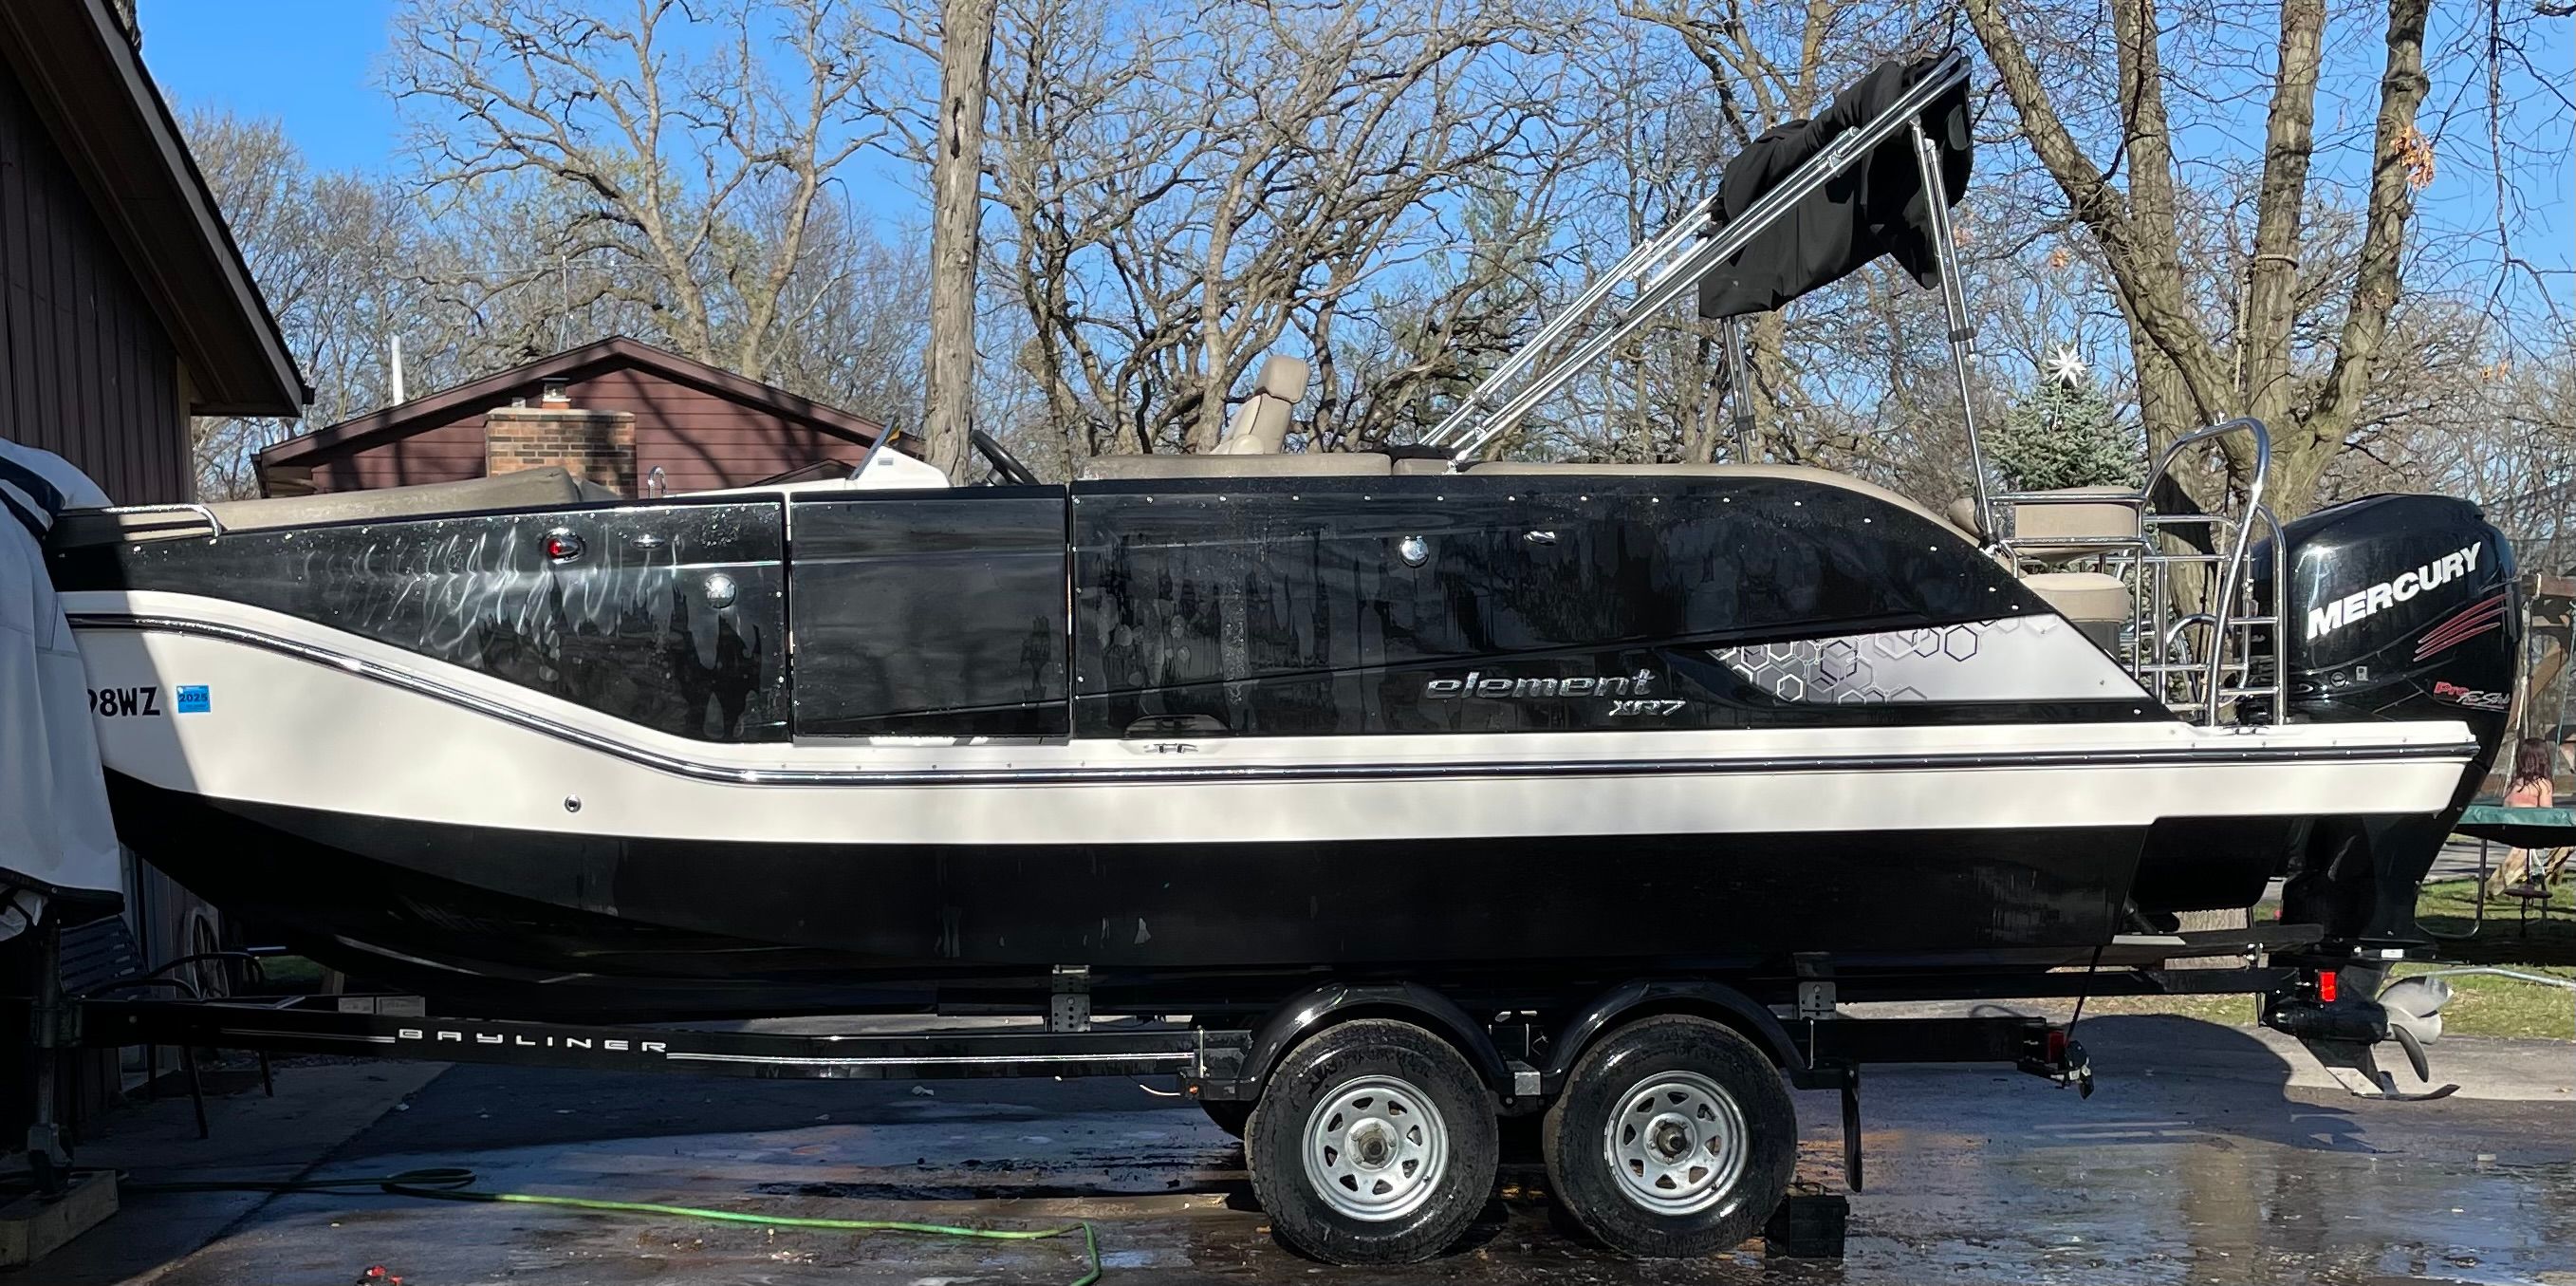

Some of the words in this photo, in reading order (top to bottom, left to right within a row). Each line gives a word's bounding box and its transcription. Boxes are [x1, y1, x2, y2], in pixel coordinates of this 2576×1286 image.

[2307, 542, 2481, 640] MERCURY
[1427, 668, 1655, 699] element
[1609, 699, 1686, 716] XR7
[398, 1028, 666, 1052] BAYLINER
